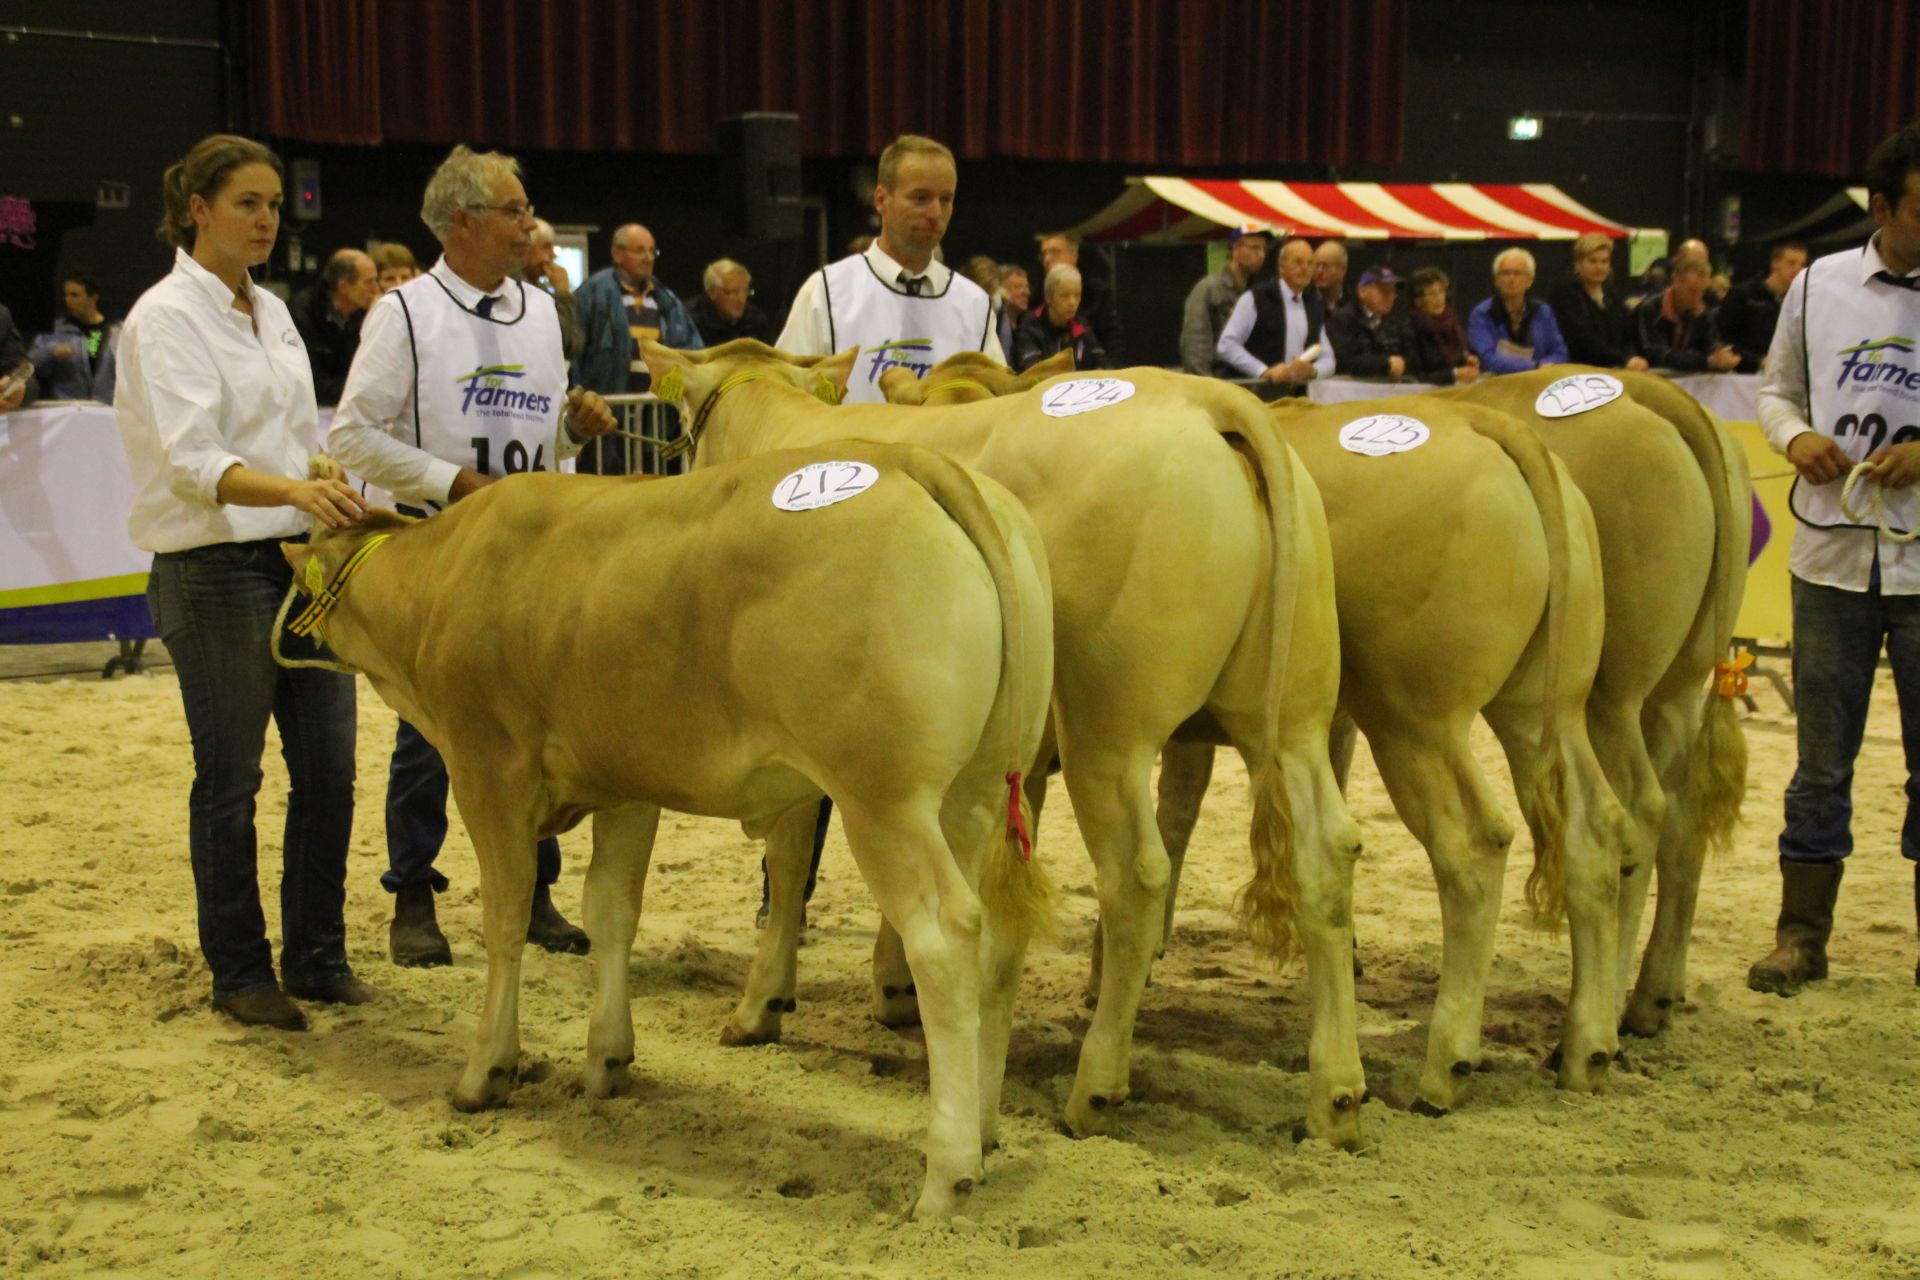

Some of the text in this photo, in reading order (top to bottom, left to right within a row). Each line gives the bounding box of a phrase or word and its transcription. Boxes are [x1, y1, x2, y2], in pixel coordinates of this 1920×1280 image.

[1047, 383, 1121, 407] 224
[1542, 377, 1617, 412] 228
[1348, 419, 1420, 446] 225
[780, 466, 866, 503] 212
